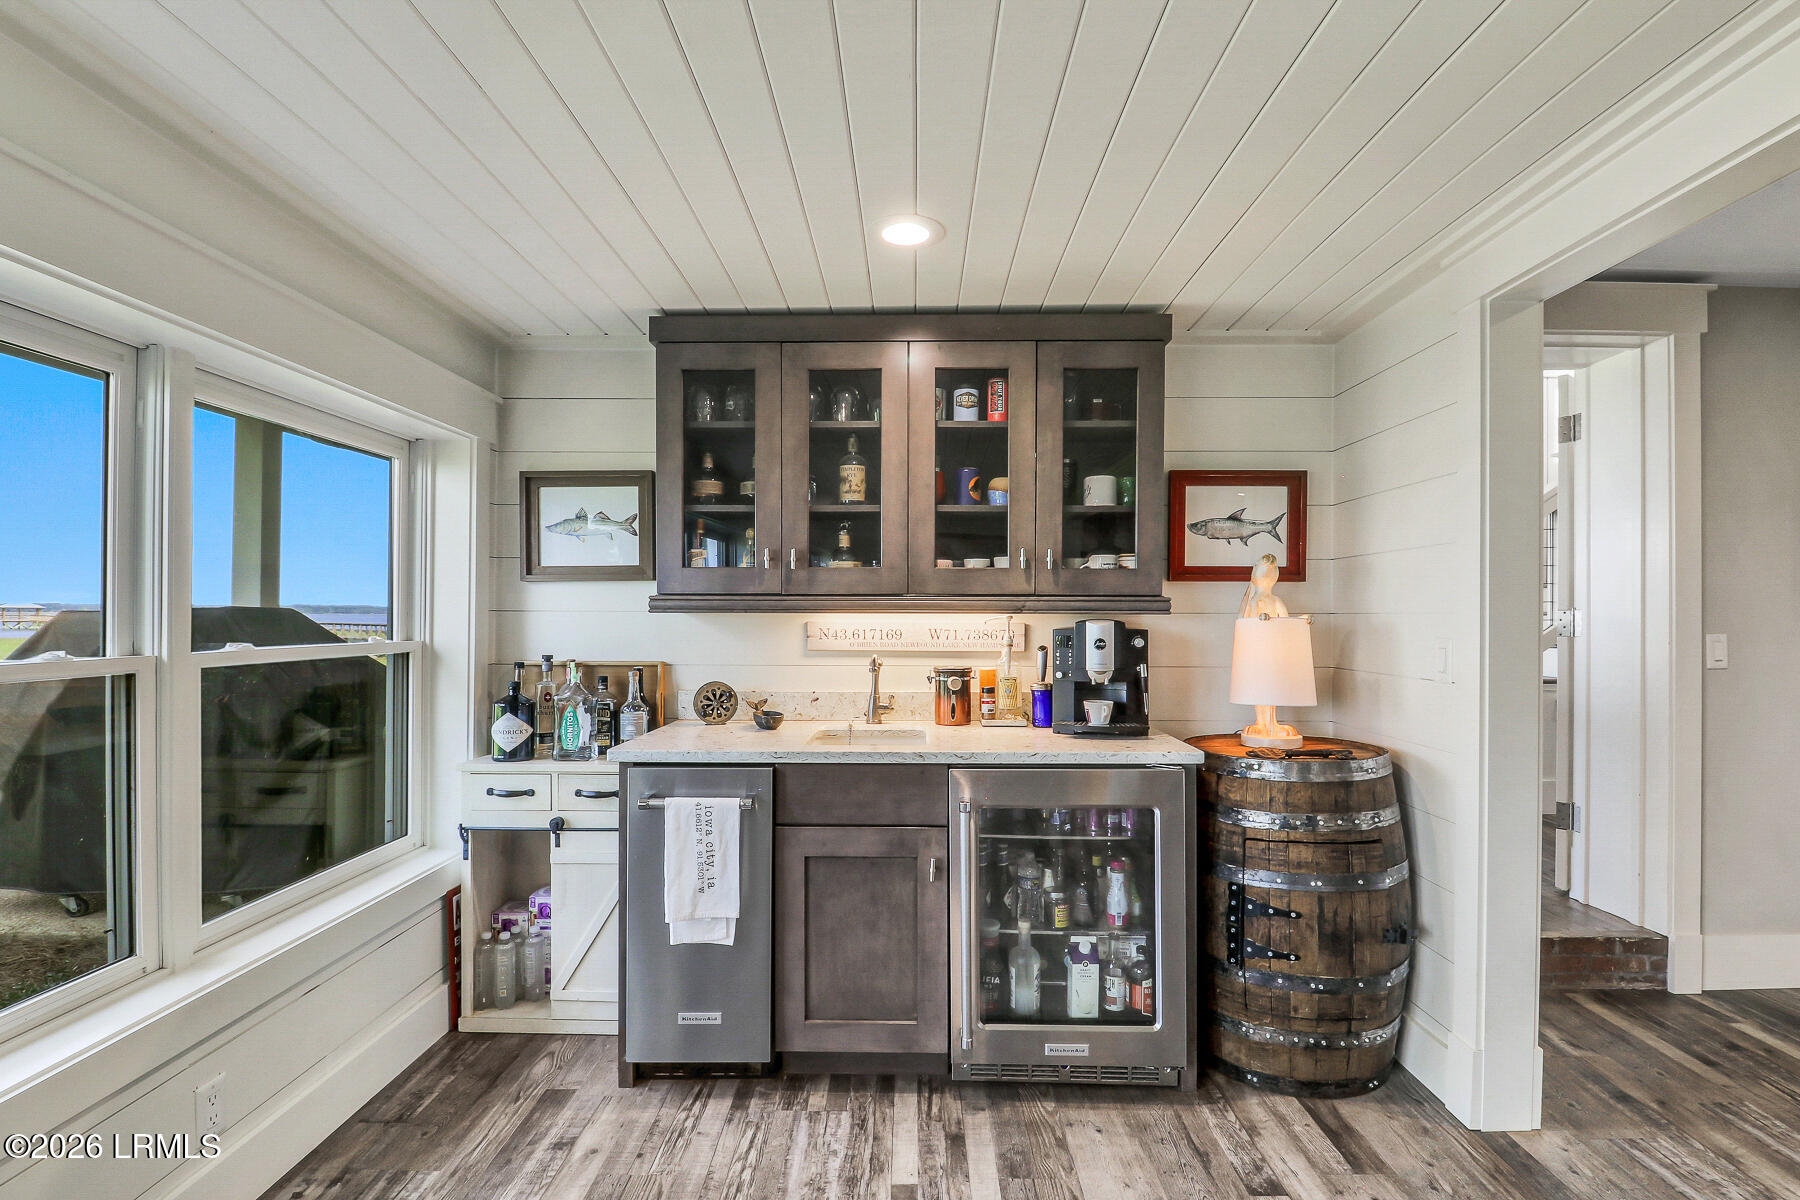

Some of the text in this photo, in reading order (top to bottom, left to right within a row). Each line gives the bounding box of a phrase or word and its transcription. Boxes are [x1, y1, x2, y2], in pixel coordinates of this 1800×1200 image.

[818, 628, 903, 640] N43.617169
[704, 806, 716, 889] iowa city, ia
